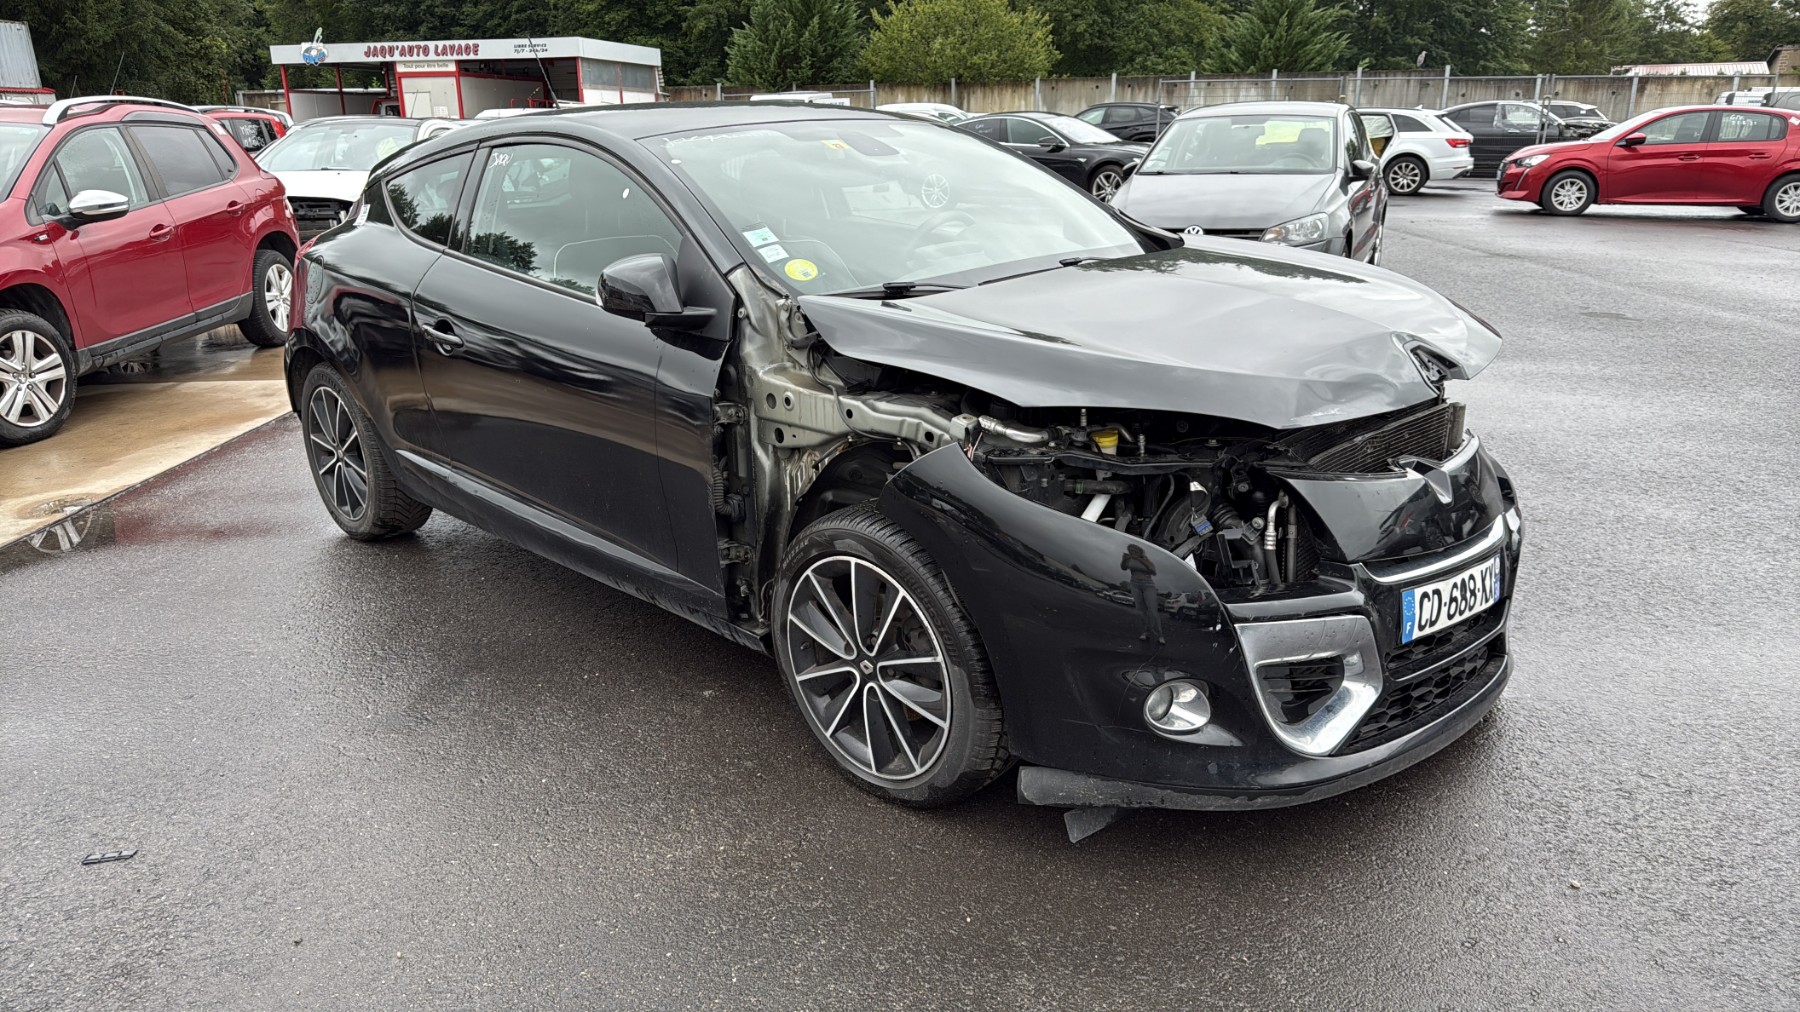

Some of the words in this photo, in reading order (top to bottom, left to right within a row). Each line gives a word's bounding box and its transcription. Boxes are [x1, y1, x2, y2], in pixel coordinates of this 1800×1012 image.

[364, 44, 430, 58] JAQU'AUTO
[434, 43, 479, 56] LAVAGE
[1418, 563, 1494, 632] CD-688-KX
[1406, 622, 1412, 634] F
